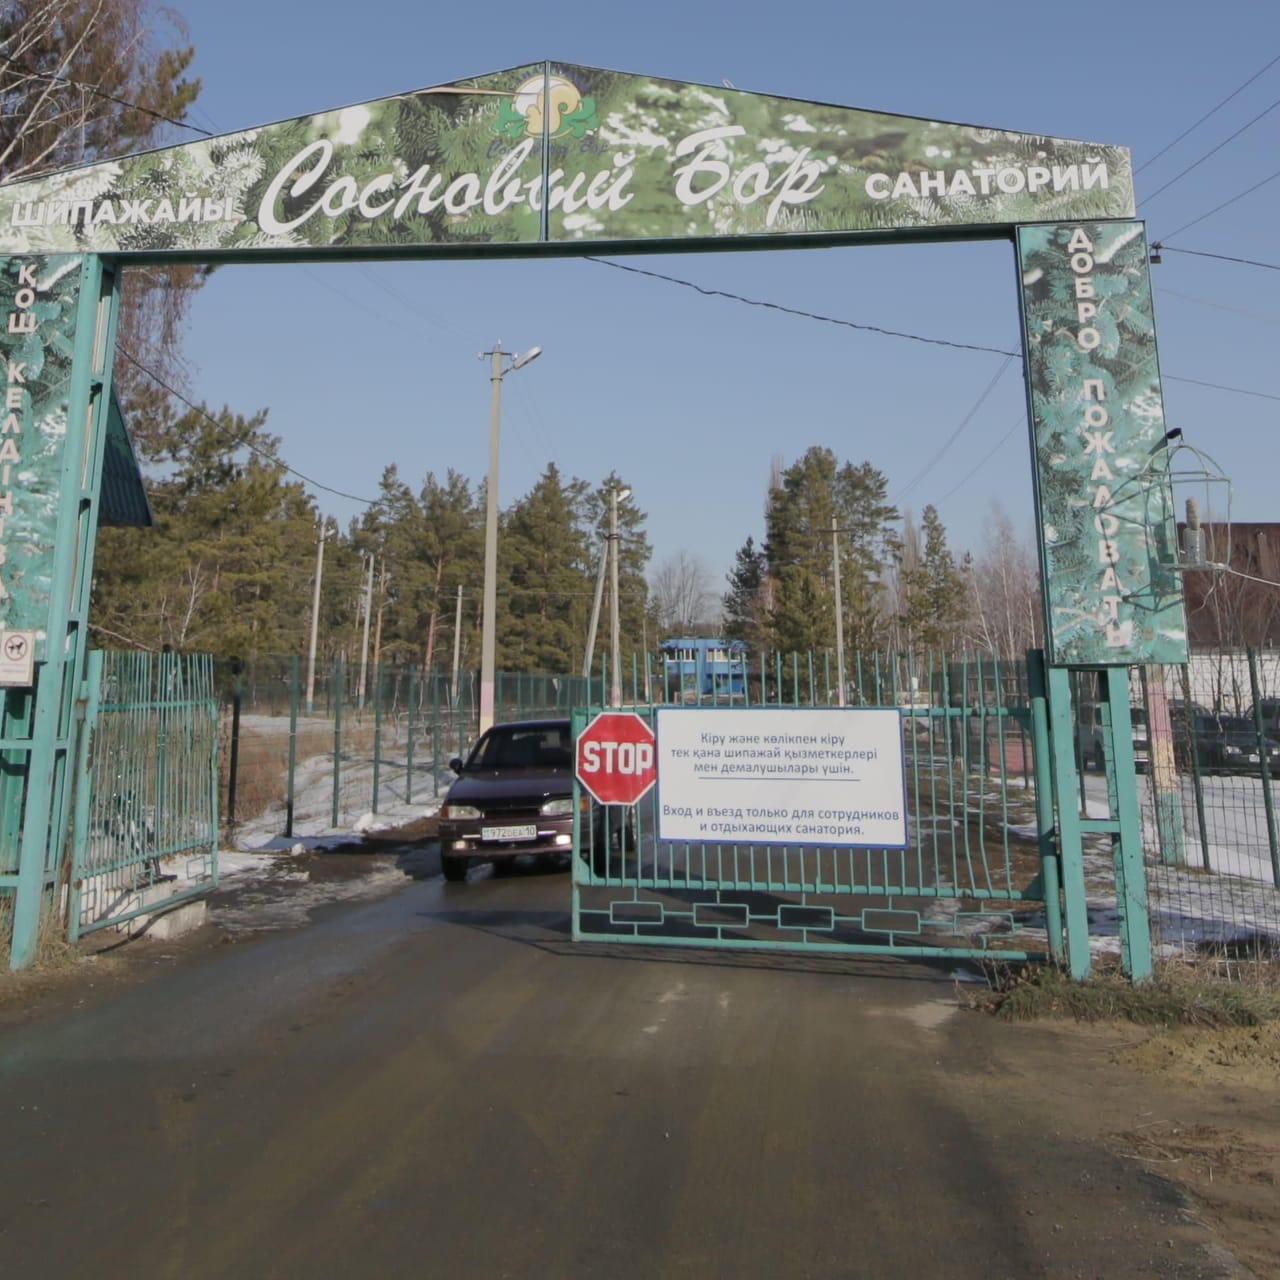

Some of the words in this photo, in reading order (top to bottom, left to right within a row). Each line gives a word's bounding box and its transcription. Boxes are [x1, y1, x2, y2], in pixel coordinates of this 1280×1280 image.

[10, 196, 233, 227] ШИПАЖАЙЫ
[258, 138, 635, 235] Сосновый
[673, 124, 825, 226] Бор
[864, 156, 1108, 200] САНАТОРИЙ
[1068, 228, 1100, 350] ДОБРО
[1081, 379, 1122, 647] ПОЖАЛОВАТЬ
[584, 740, 653, 776] STOP
[671, 748, 690, 758] тек
[693, 749, 720, 759] қана
[724, 746, 780, 759] шипажай
[784, 748, 877, 761] қызметкерлері
[694, 763, 718, 772] мен
[721, 763, 818, 775] демалушылары
[663, 804, 693, 818] Вход
[696, 807, 703, 816] и
[707, 807, 743, 819] въезд
[746, 808, 788, 818] только
[791, 809, 815, 820] для
[818, 810, 900, 821] сотрудников
[700, 823, 707, 832] и
[711, 823, 792, 836] отдыхающих
[796, 824, 865, 837] санатория.
